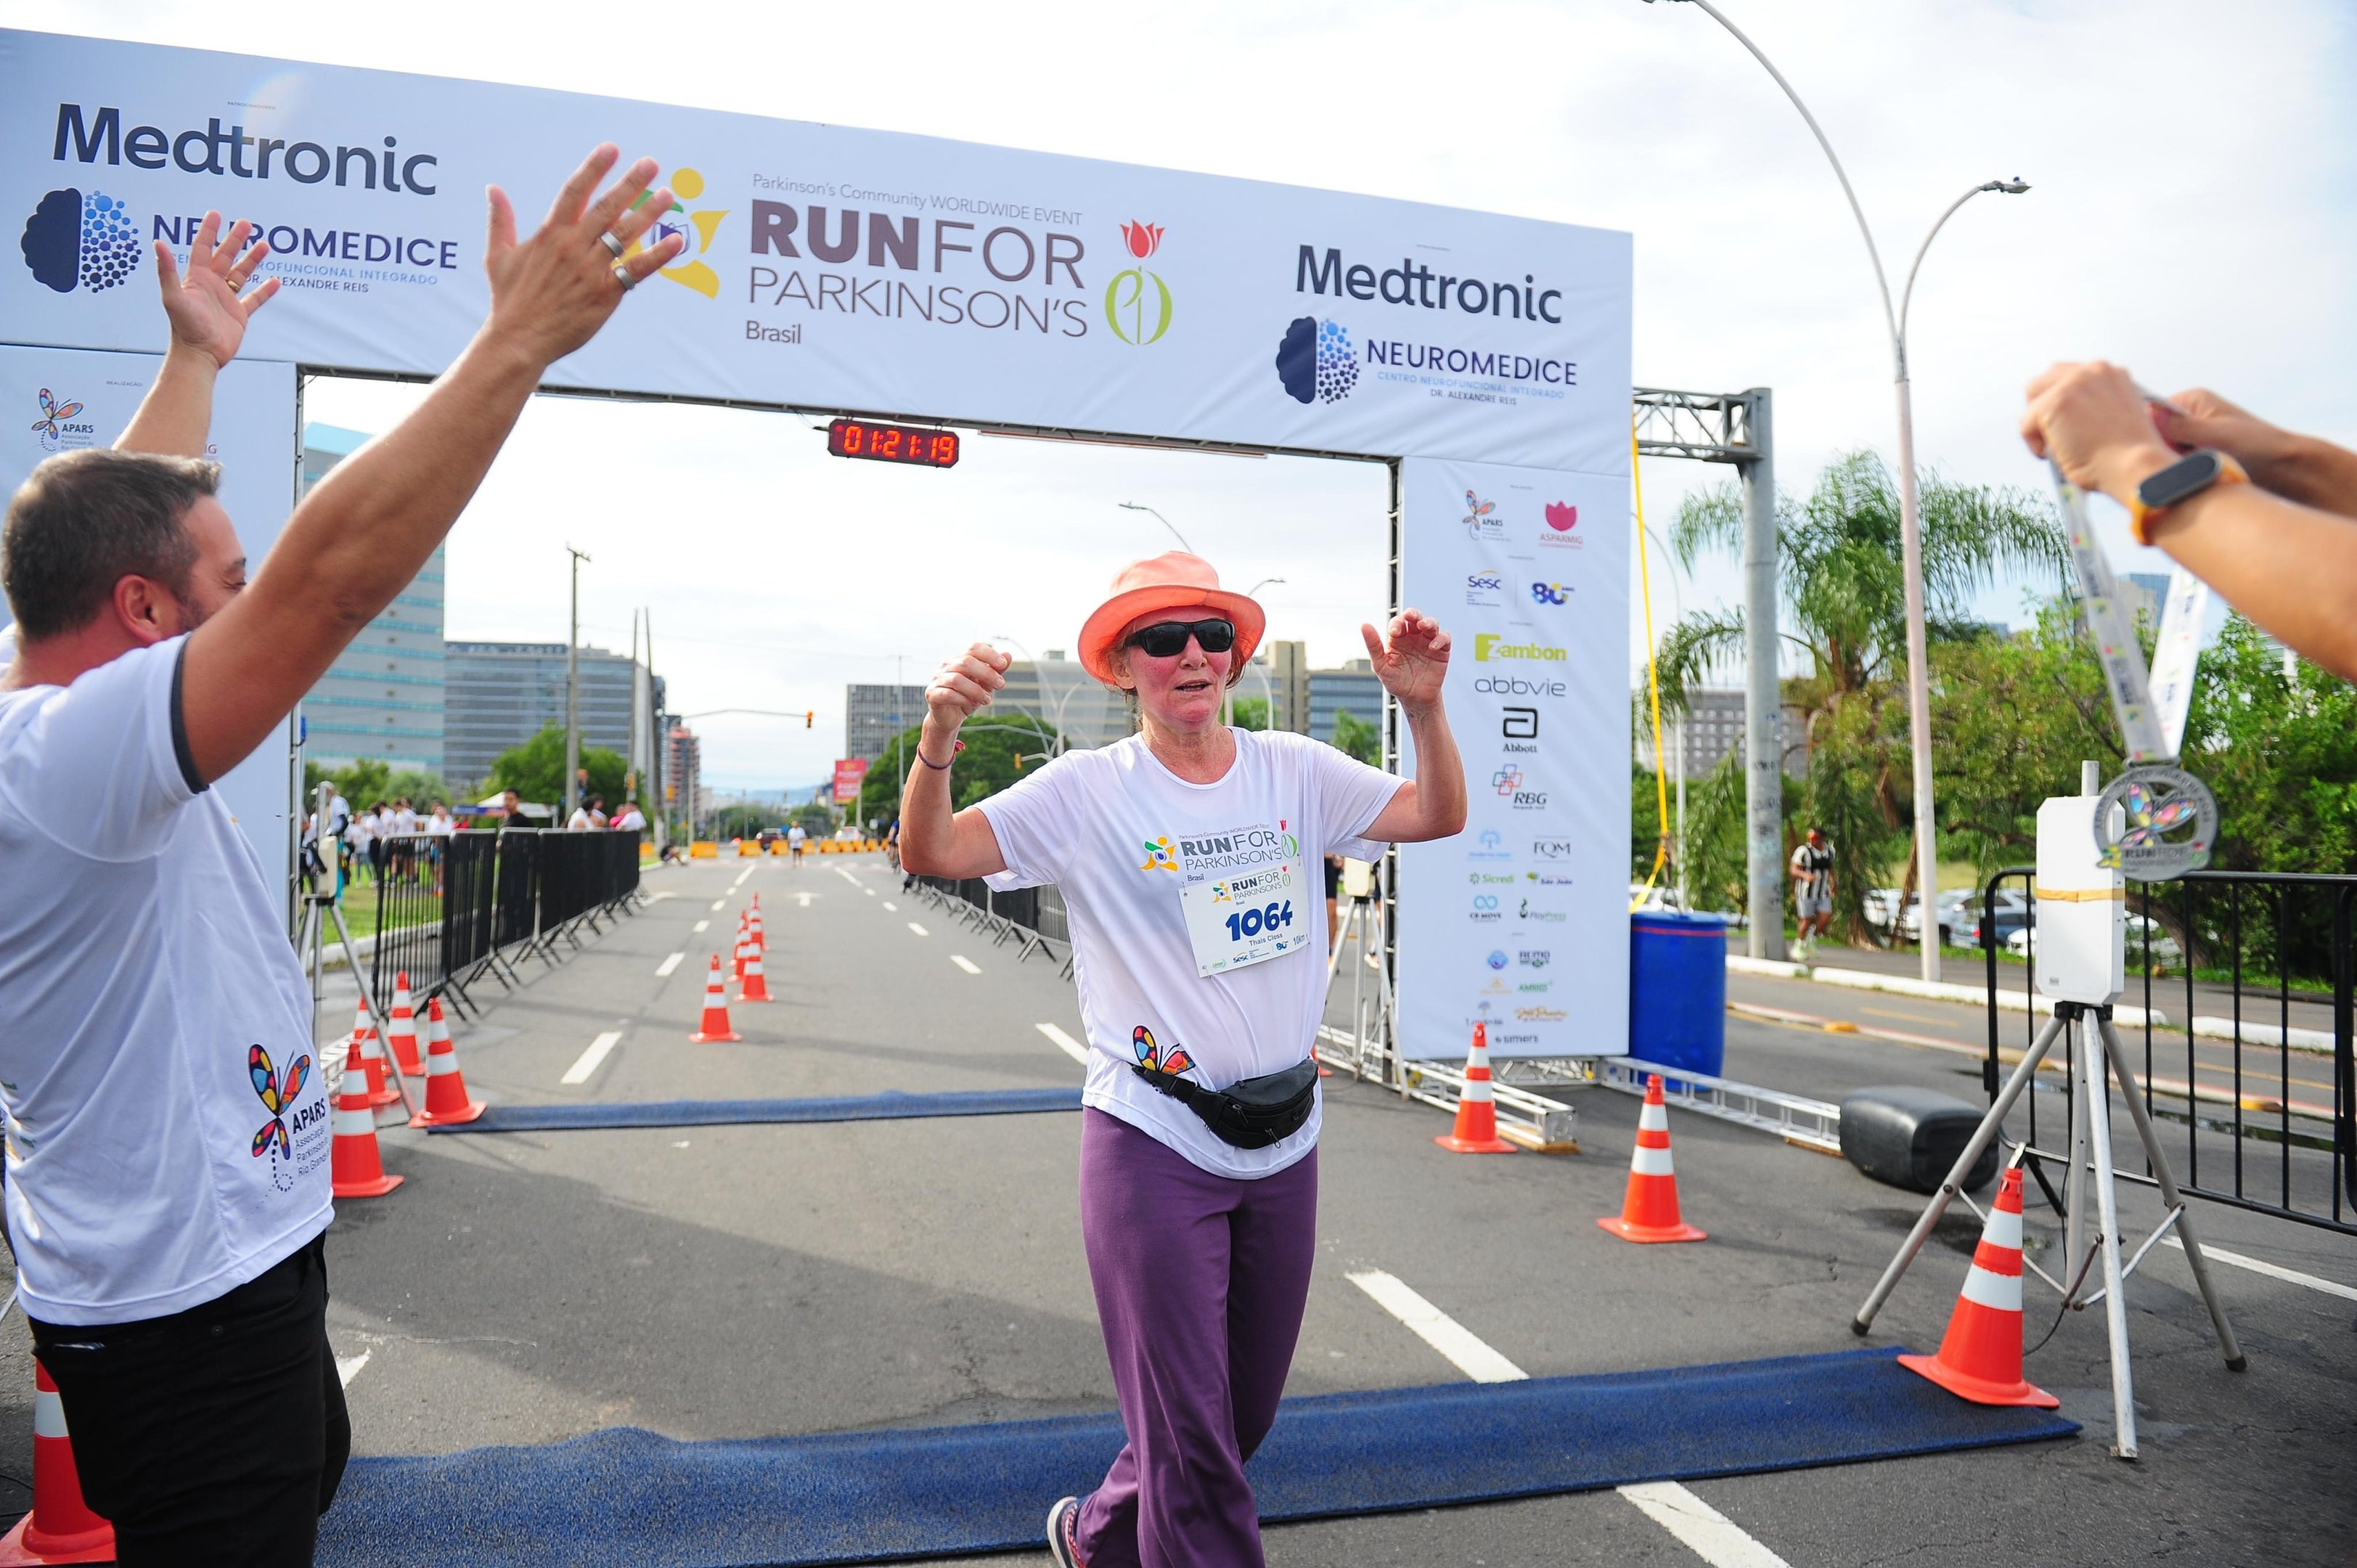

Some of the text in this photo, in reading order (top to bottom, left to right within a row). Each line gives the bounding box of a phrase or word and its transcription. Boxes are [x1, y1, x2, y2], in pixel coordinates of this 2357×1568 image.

[53, 103, 437, 195] Medtronic
[752, 173, 1083, 226] Parkinson's Community WORLDWIDE EVENT
[343, 282, 369, 293] REIS
[360, 269, 438, 285] INTEGRADO
[1296, 244, 1562, 324] Medtronic
[748, 266, 1087, 338] PARKINSON'S
[746, 321, 801, 345] Brasil
[1368, 339, 1578, 386] NEUROMEDICE
[1378, 371, 1564, 399] CENTRO NEUROFUNCIONAL INTEGRADO
[1431, 388, 1518, 405] DR. ALEXANDRE REIS
[62, 423, 94, 433] APARS
[843, 425, 955, 464] 01:21:19
[1540, 532, 1584, 544] ASPARMIG
[1475, 633, 1568, 662] Zambon
[1474, 675, 1566, 698] abbvie
[1503, 743, 1537, 753] Abbott
[1514, 791, 1548, 805] RBG
[1185, 847, 1283, 870] PARKINSON'S
[1187, 873, 1205, 882] Brasil
[1483, 873, 1515, 883] Sicredi
[1234, 881, 1283, 899] PARKINSON'S
[1225, 899, 1294, 942] 1064
[1267, 933, 1283, 942] Closs
[293, 1097, 326, 1135] APARS
[298, 1164, 309, 1177] Rio
